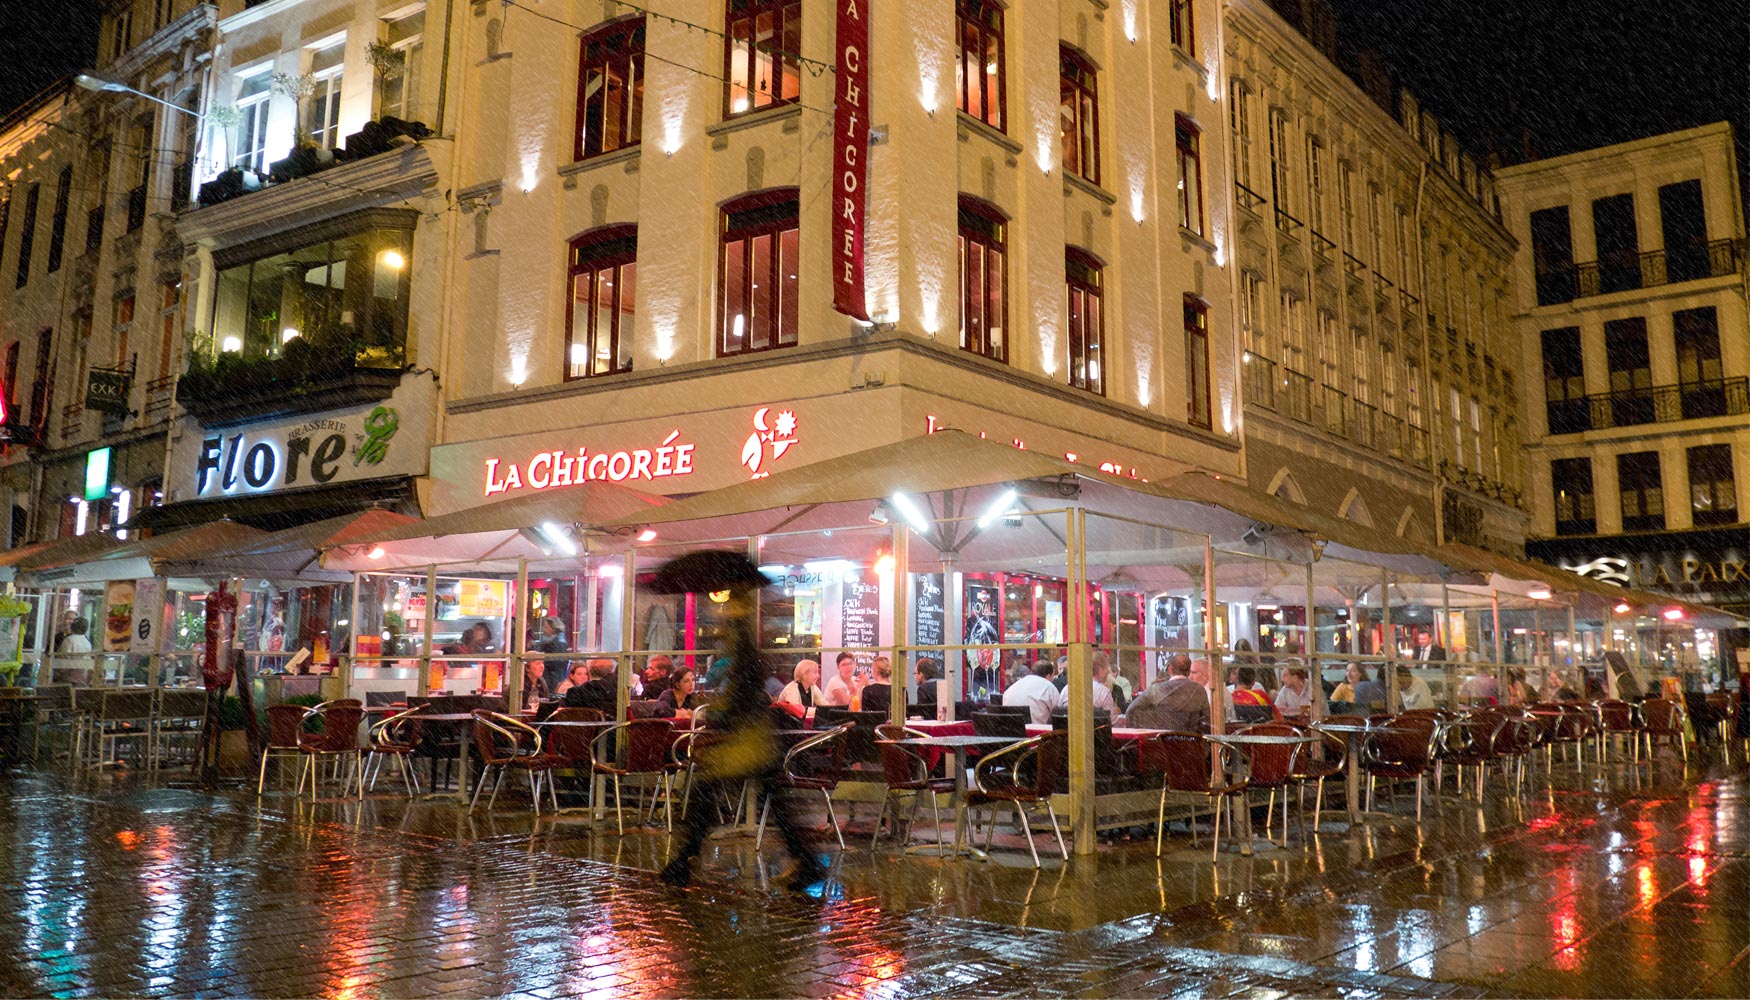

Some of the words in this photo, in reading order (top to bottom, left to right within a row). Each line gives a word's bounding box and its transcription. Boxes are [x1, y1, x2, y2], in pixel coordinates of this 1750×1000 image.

[288, 420, 347, 440] BRASSERIE
[197, 433, 346, 495] Flore
[971, 602, 997, 617] ROYALE
